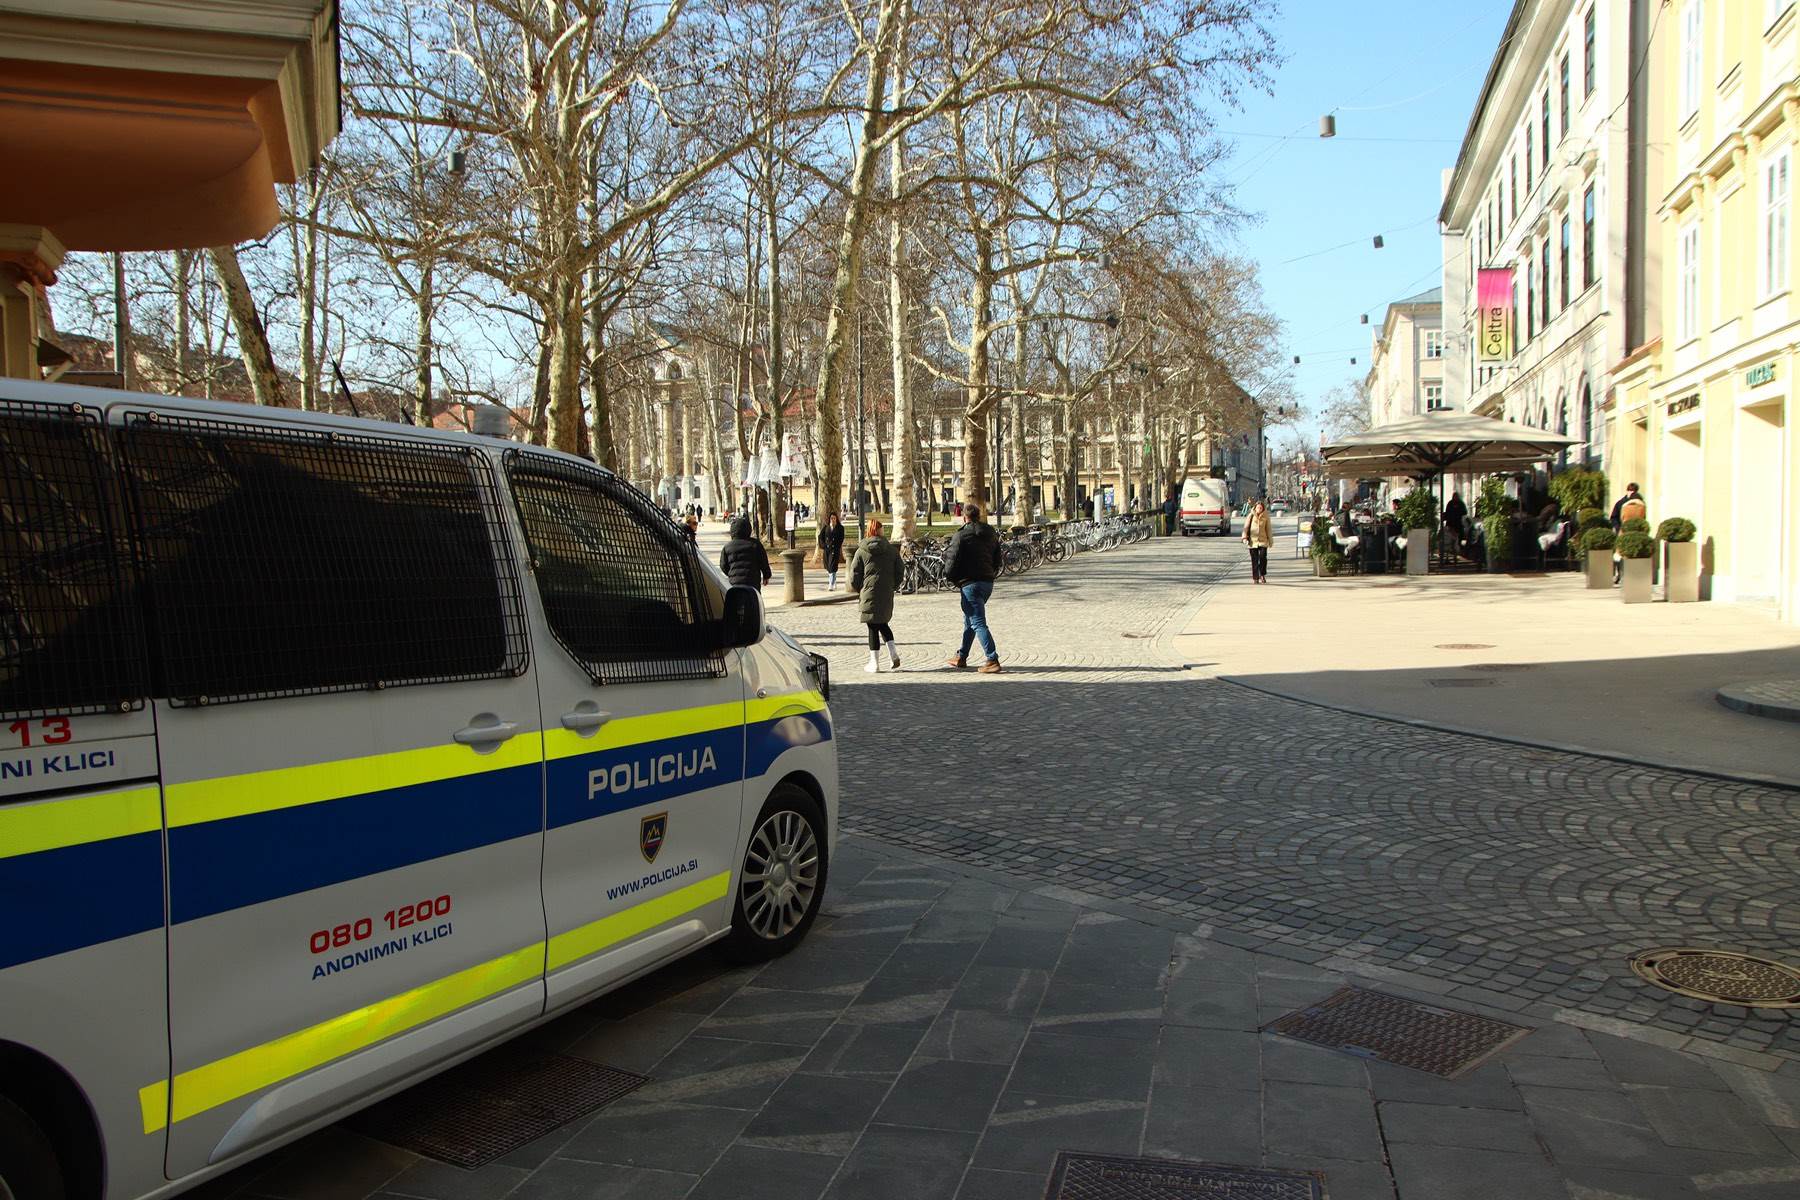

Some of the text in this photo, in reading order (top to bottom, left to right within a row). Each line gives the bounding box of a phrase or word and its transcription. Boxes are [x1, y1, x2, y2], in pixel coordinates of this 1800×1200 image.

[1487, 307, 1502, 356] Celtra
[43, 751, 115, 774] KLICI
[588, 746, 717, 800] POLICIJA
[606, 859, 699, 900] WWW.POLICIJA.SI
[310, 895, 451, 954] 080 1200
[312, 923, 453, 980] ANONIMNI KLICI
